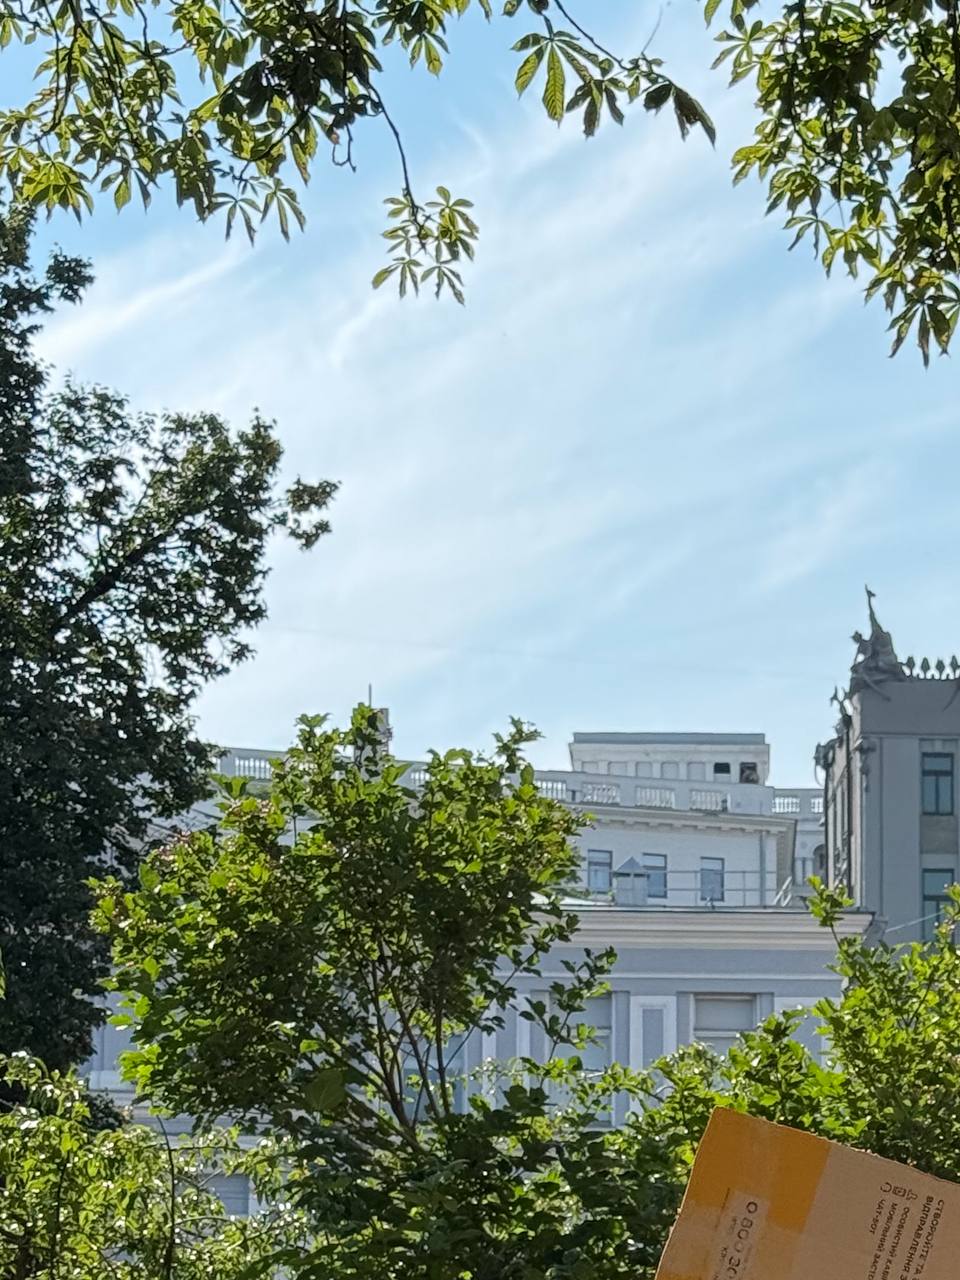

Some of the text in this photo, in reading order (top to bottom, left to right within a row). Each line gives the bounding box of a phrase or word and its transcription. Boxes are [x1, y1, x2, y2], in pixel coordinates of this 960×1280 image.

[746, 1201, 757, 1213] 0
[868, 1198, 886, 1235] ЧАТ-БОТ
[901, 1195, 934, 1273] ВІДПРАВЛЕННЯ
[918, 1198, 945, 1261] СТВОРЮЙТЕ
[913, 1262, 925, 1275] ТА
